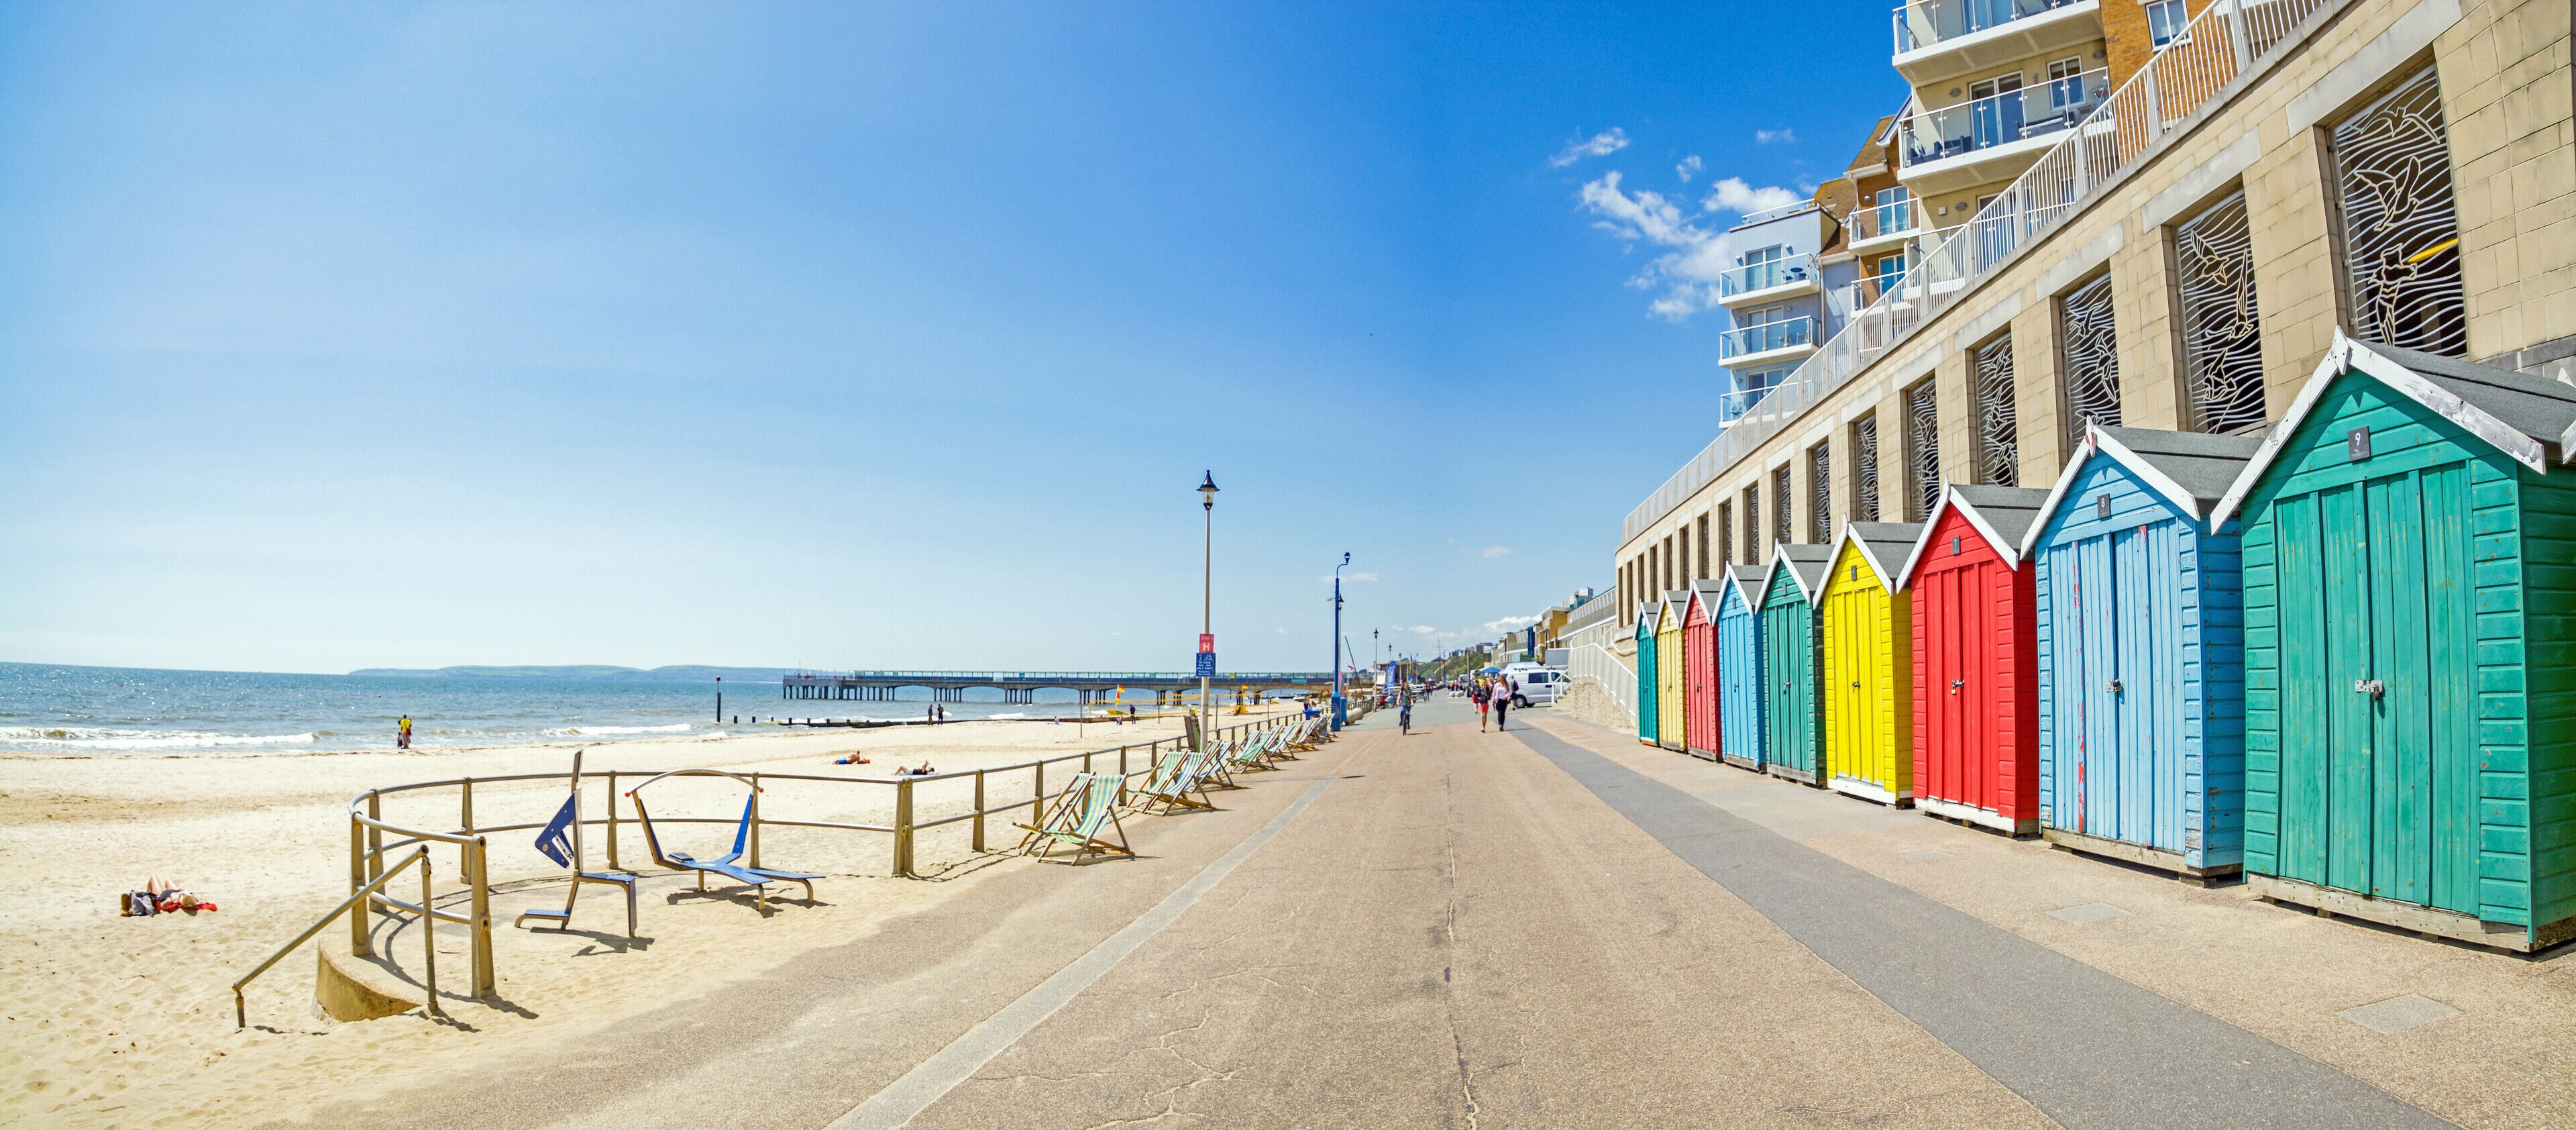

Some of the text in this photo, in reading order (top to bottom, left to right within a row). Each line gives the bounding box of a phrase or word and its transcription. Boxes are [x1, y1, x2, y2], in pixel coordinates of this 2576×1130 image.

[2355, 432, 2361, 446] 9
[2101, 498, 2105, 507] 8
[1203, 642, 1210, 652] H
